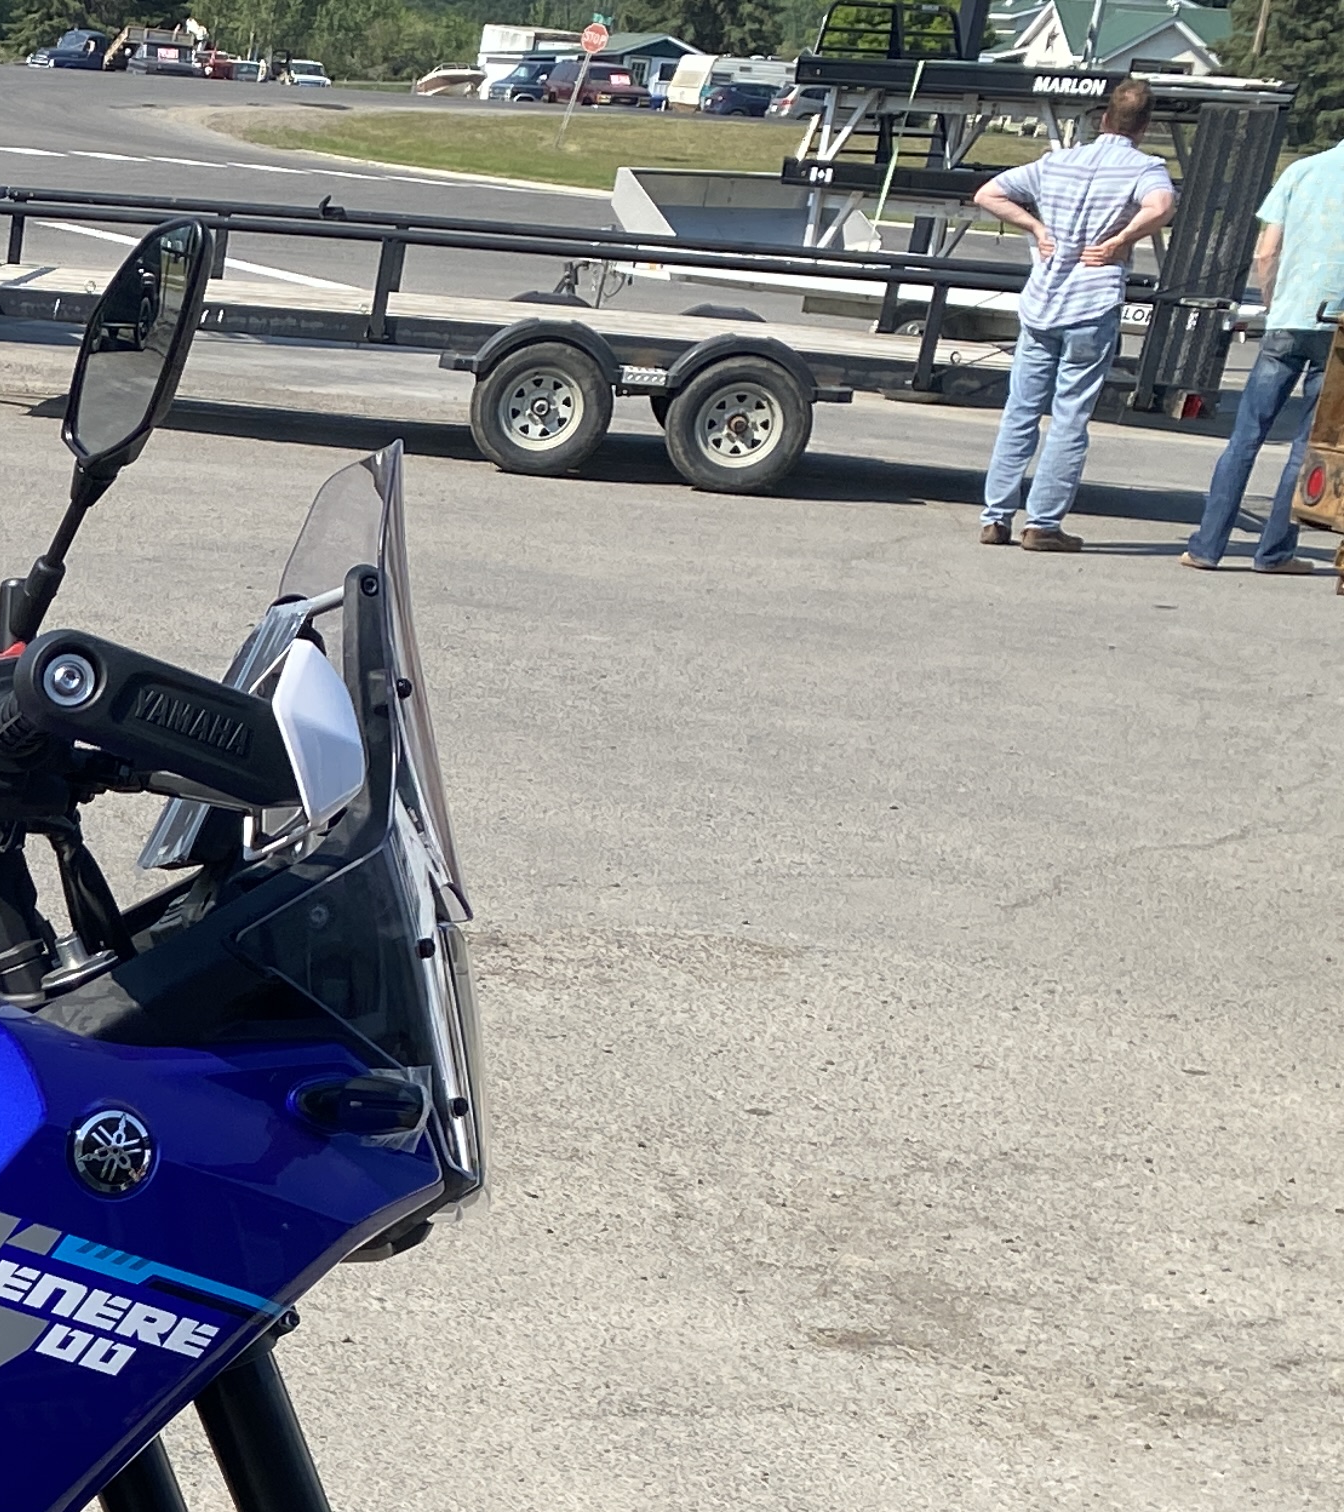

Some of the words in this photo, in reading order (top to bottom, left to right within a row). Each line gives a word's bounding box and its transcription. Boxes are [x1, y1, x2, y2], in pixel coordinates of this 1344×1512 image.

[581, 30, 608, 47] STOP
[1032, 75, 1108, 97] MARLON
[133, 686, 250, 756] YAMAHA
